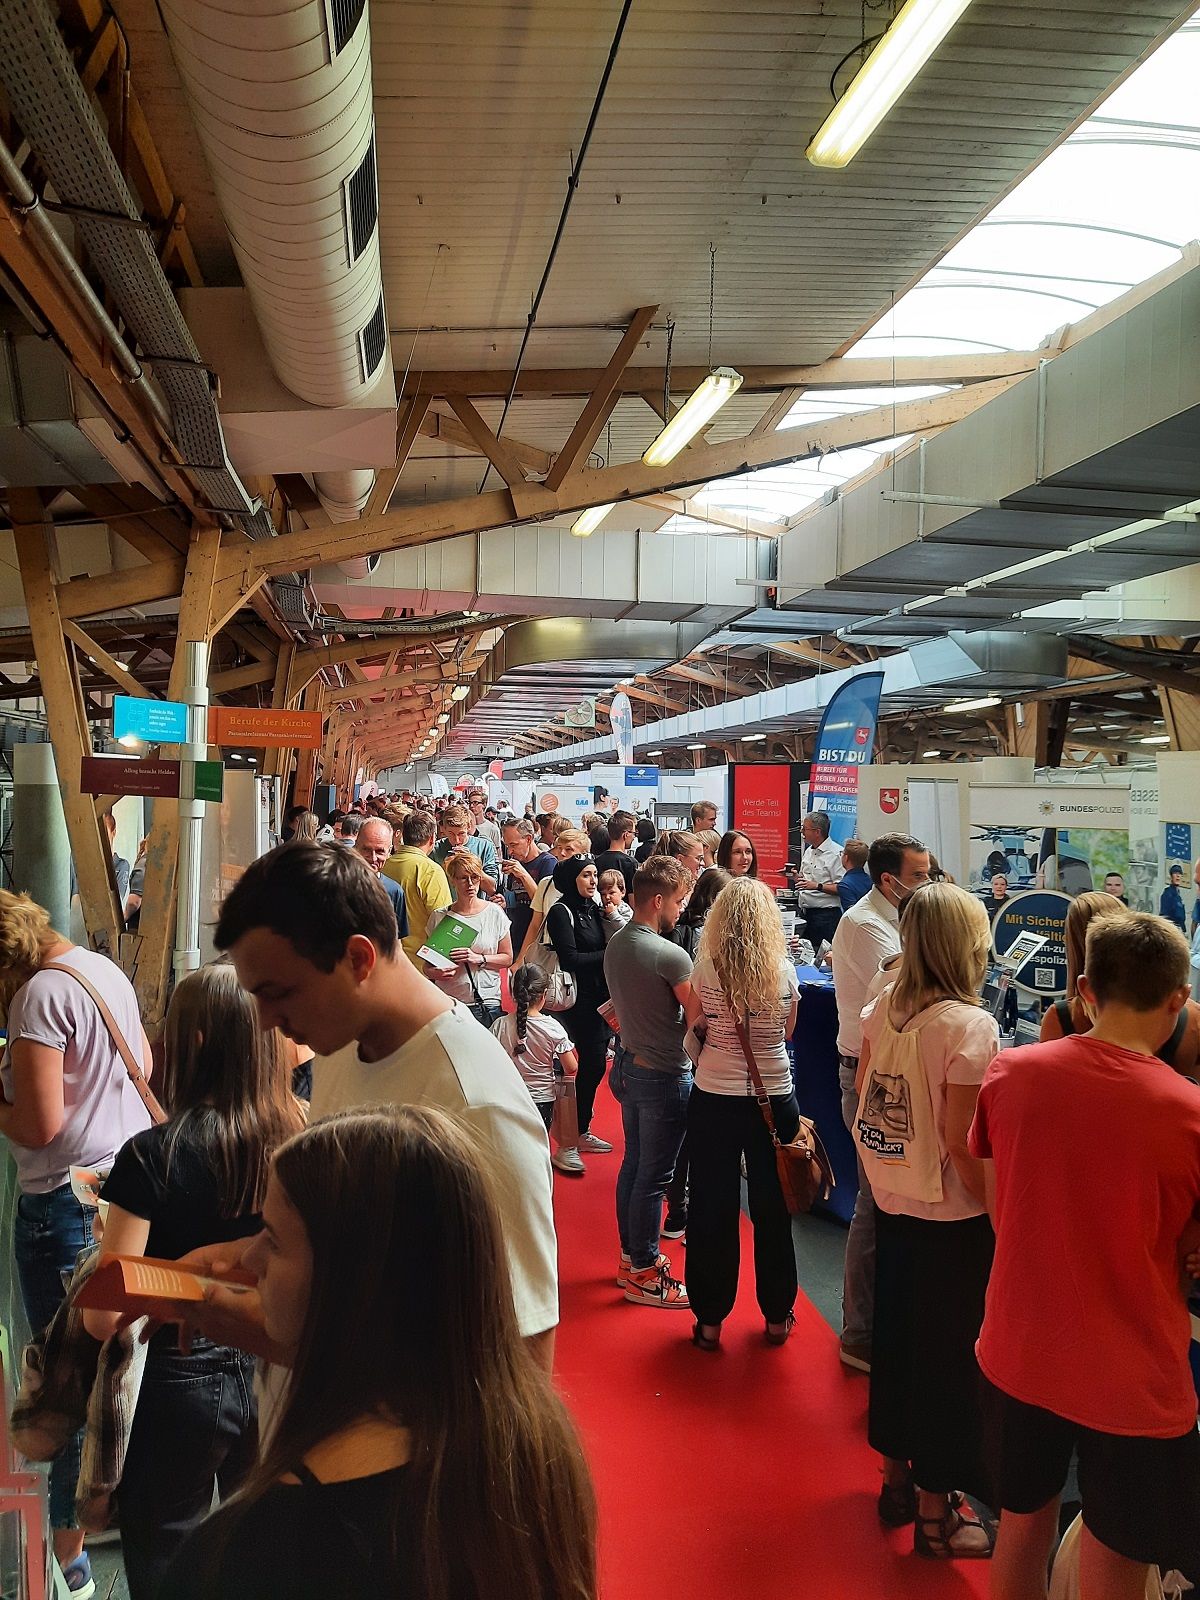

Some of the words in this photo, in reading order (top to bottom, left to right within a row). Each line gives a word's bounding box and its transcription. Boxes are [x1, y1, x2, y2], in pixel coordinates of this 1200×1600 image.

[230, 716, 260, 726] Berufe
[263, 717, 279, 726] der
[281, 718, 312, 728] Kirche
[818, 748, 846, 762] BIST
[846, 750, 866, 763] DU
[742, 798, 765, 807] Werde
[766, 798, 779, 807] Teil
[742, 809, 755, 817] des
[1059, 805, 1125, 814] BUNDESPOLIZEI
[1005, 913, 1023, 924] Mit
[1026, 915, 1065, 928] Sicher
